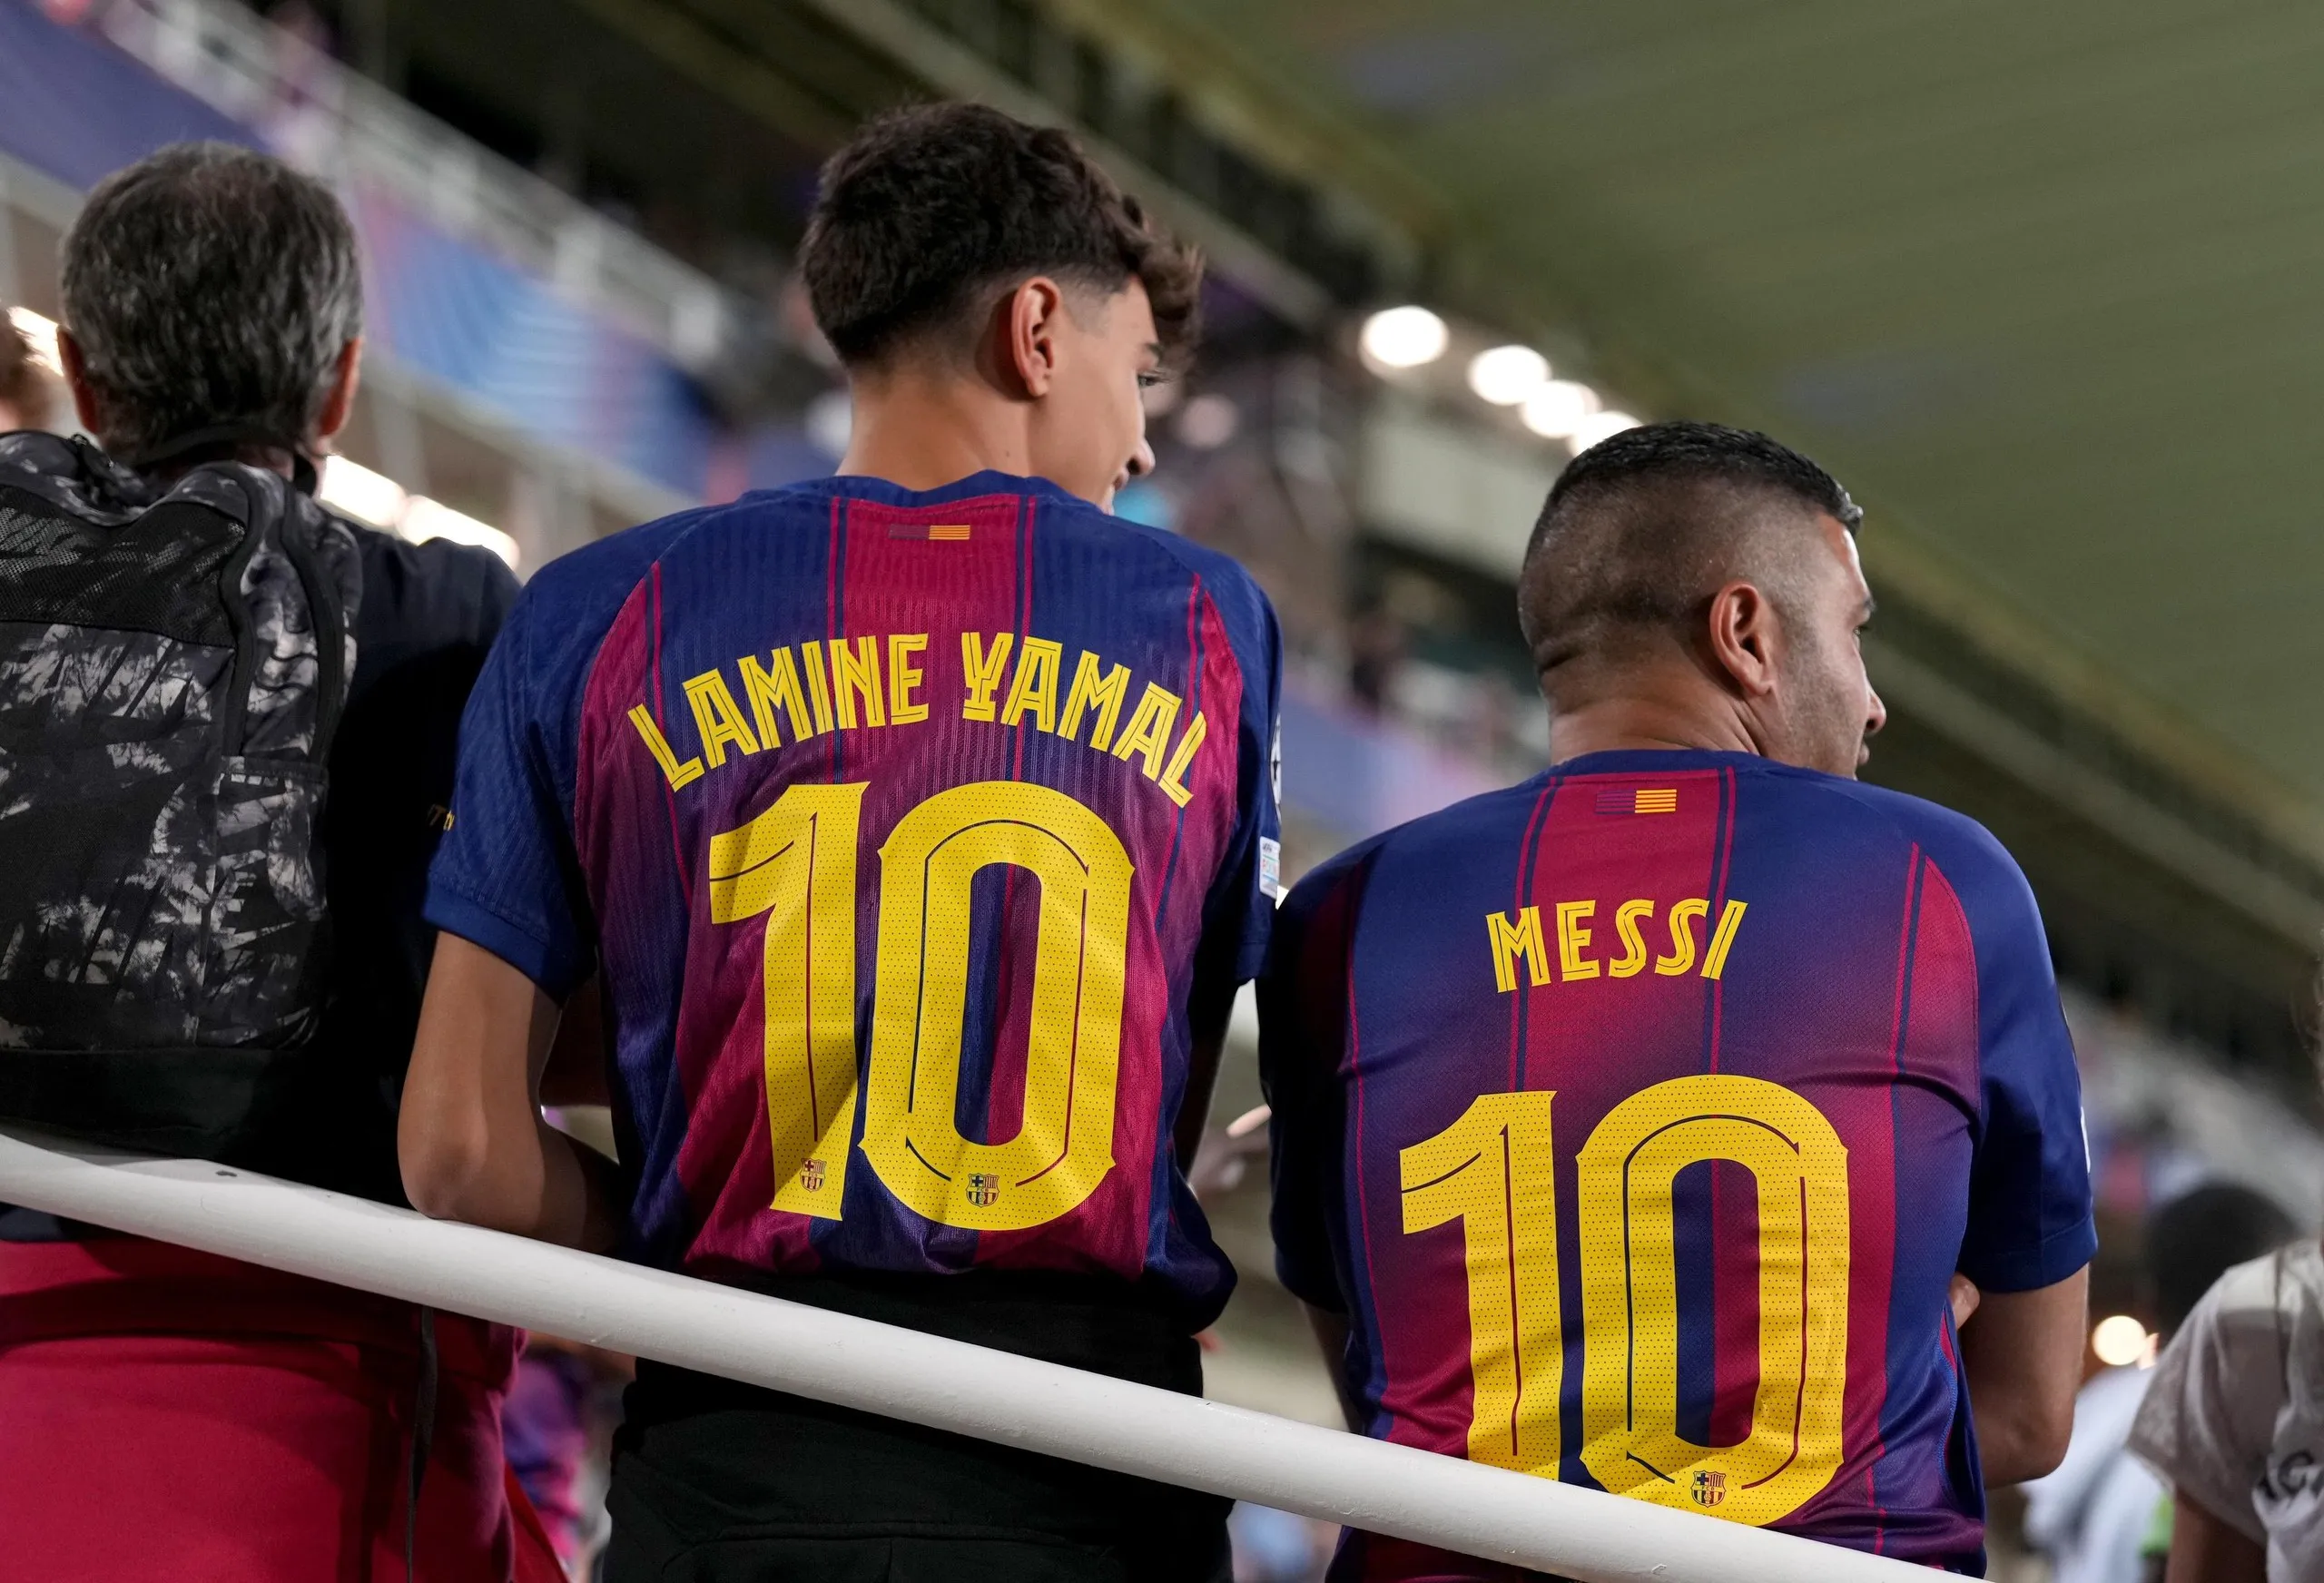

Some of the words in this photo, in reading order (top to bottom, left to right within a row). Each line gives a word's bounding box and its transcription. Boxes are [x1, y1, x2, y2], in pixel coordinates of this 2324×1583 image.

[628, 634, 928, 791] LAMINE
[962, 633, 1206, 806] YAMAL
[710, 781, 1134, 1231] 10
[1486, 899, 1748, 993] MESSI
[1400, 1075, 1849, 1528] 10
